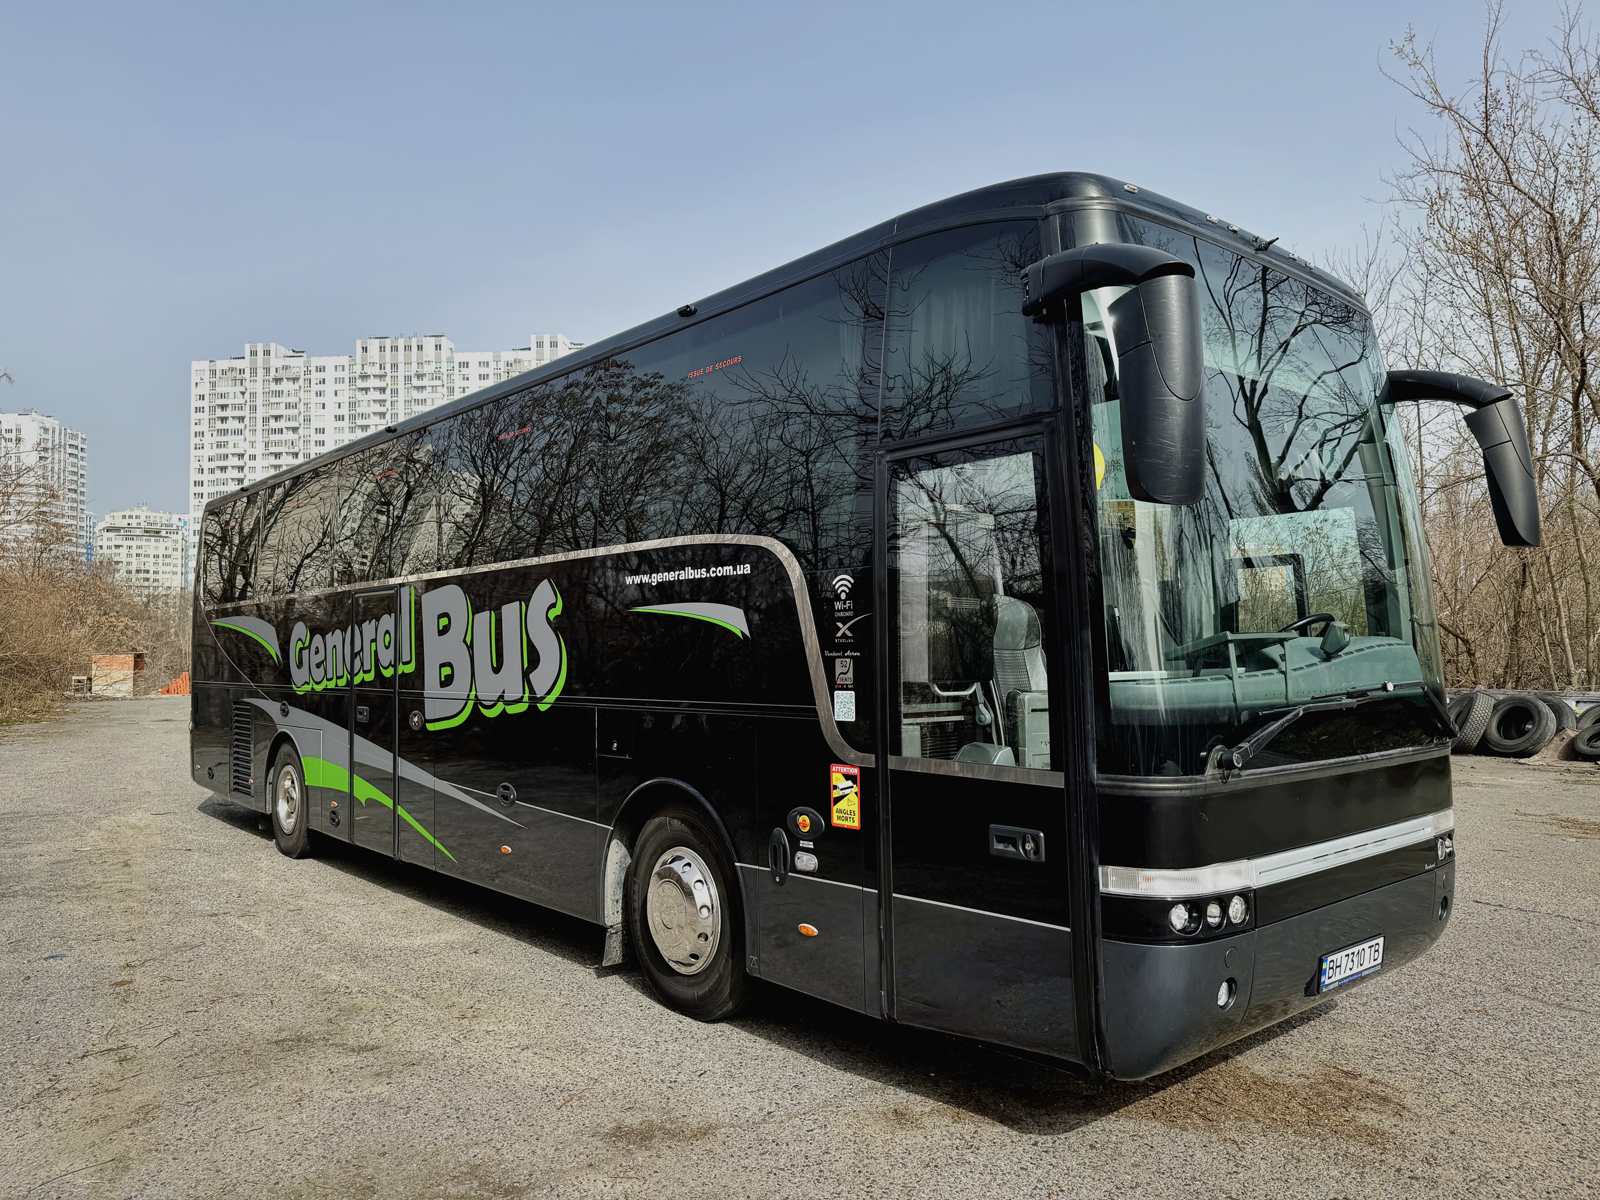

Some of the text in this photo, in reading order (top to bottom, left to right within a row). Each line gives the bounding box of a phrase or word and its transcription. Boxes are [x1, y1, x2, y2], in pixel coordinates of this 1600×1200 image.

[625, 563, 751, 586] www.generalbus.com.ua
[834, 601, 853, 610] Wi-Fi
[289, 578, 567, 731] General Bus
[835, 808, 855, 816] ANGLES
[836, 815, 855, 823] MORTS
[1344, 948, 1365, 973] 7310
[1368, 942, 1380, 964] TB
